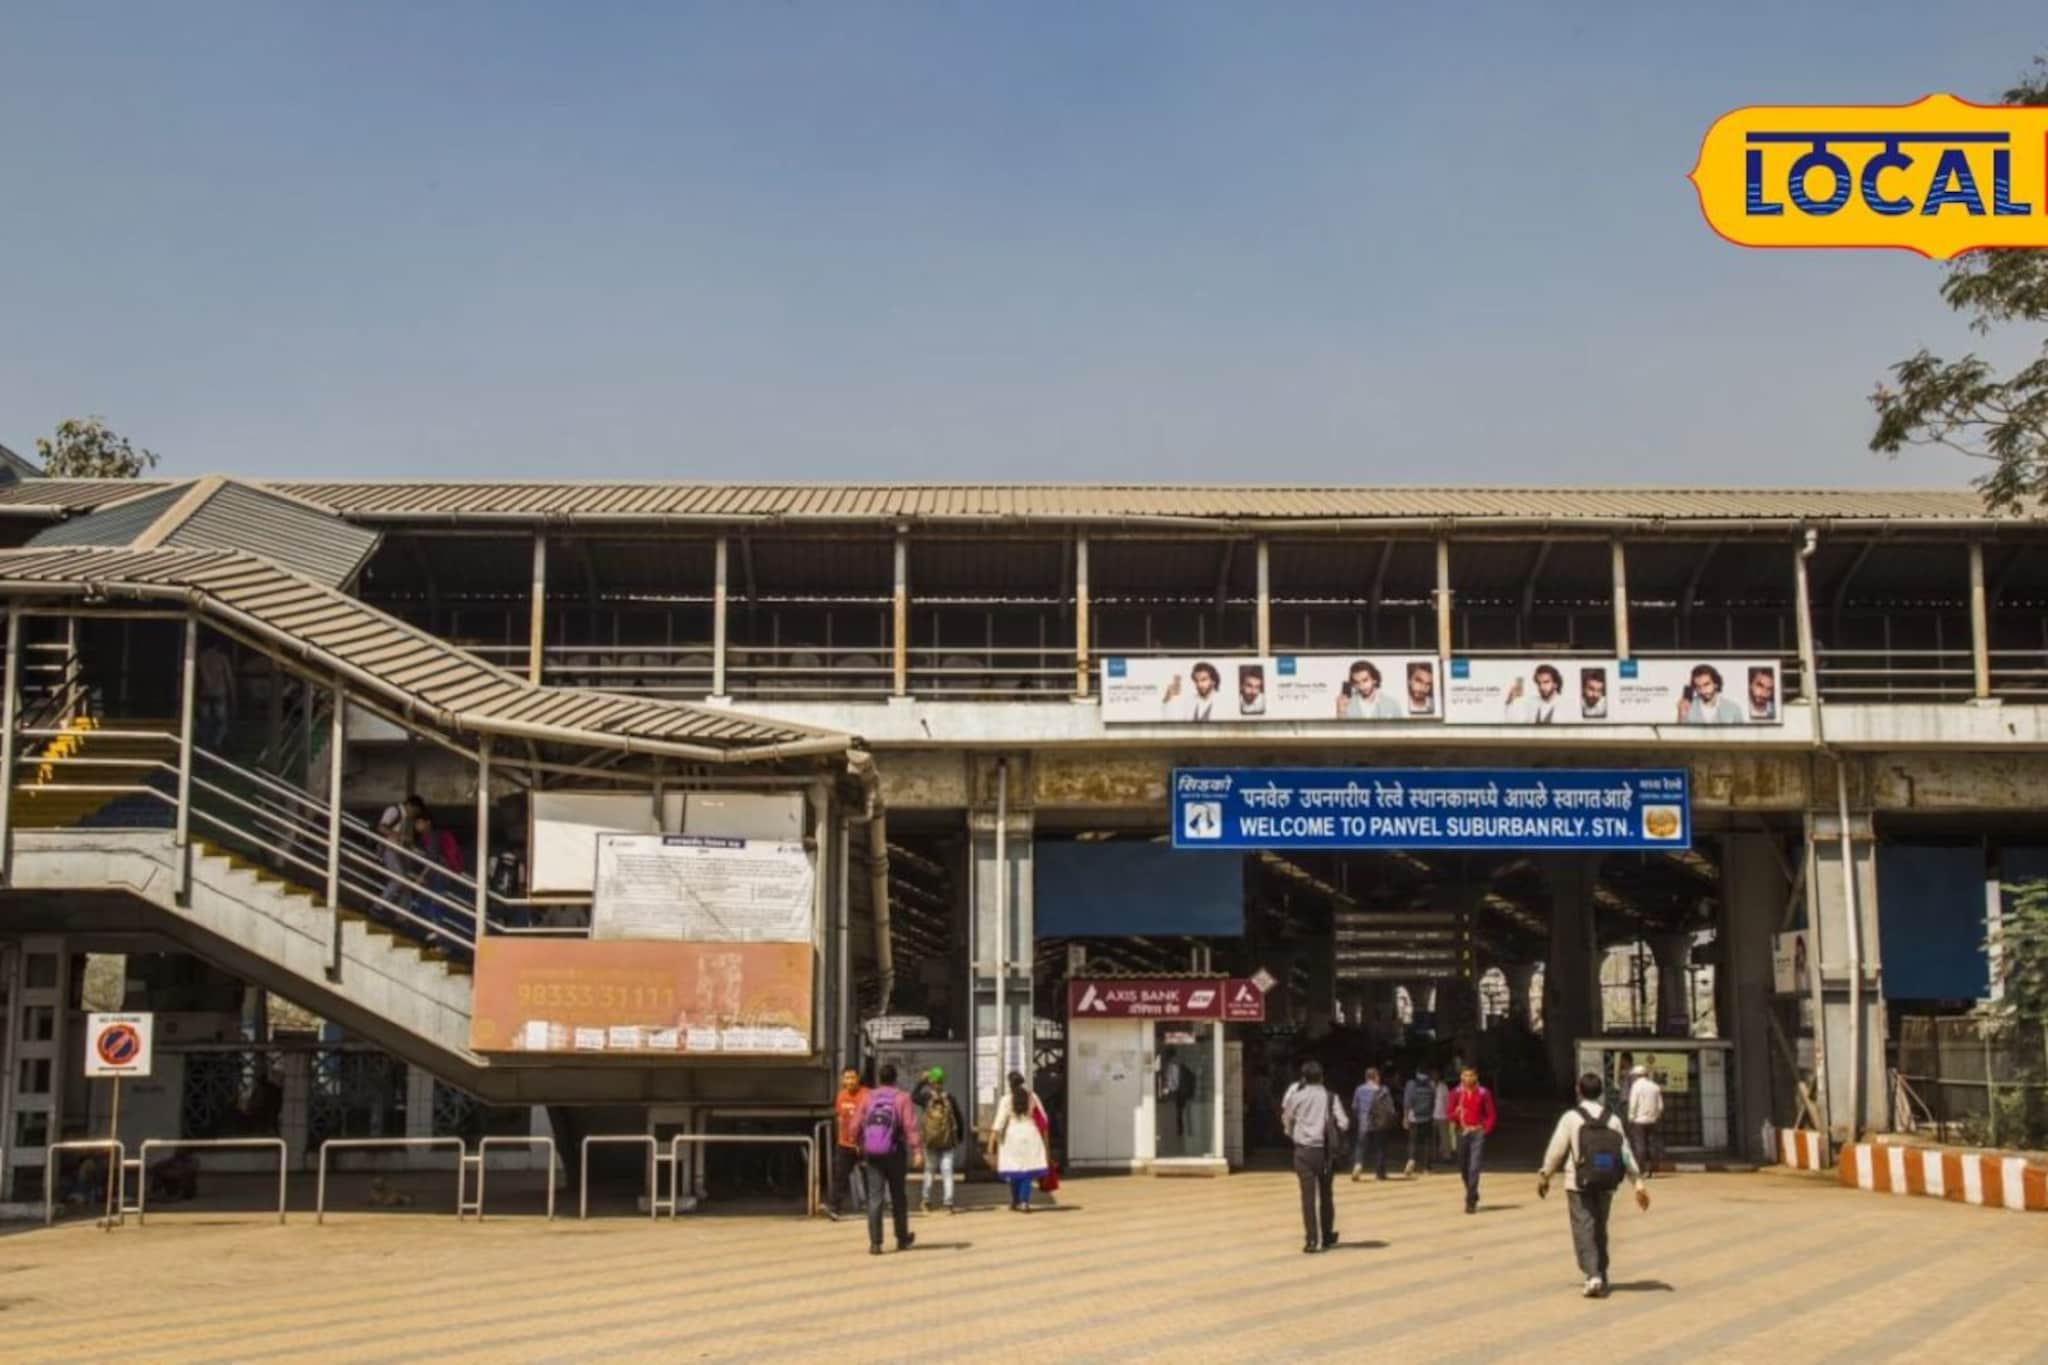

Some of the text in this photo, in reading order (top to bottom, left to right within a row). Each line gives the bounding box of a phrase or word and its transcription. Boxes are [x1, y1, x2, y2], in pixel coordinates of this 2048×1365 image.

[1240, 780, 1293, 808] पनवेल
[1300, 781, 1370, 808] उपनगरीय
[1504, 781, 1547, 808] आपले
[1240, 816, 1634, 837] WELCOME TO PANVEL SUBURBAN RLY. STN.
[1106, 990, 1137, 1001] AXIS
[1141, 990, 1180, 1001] BANK
